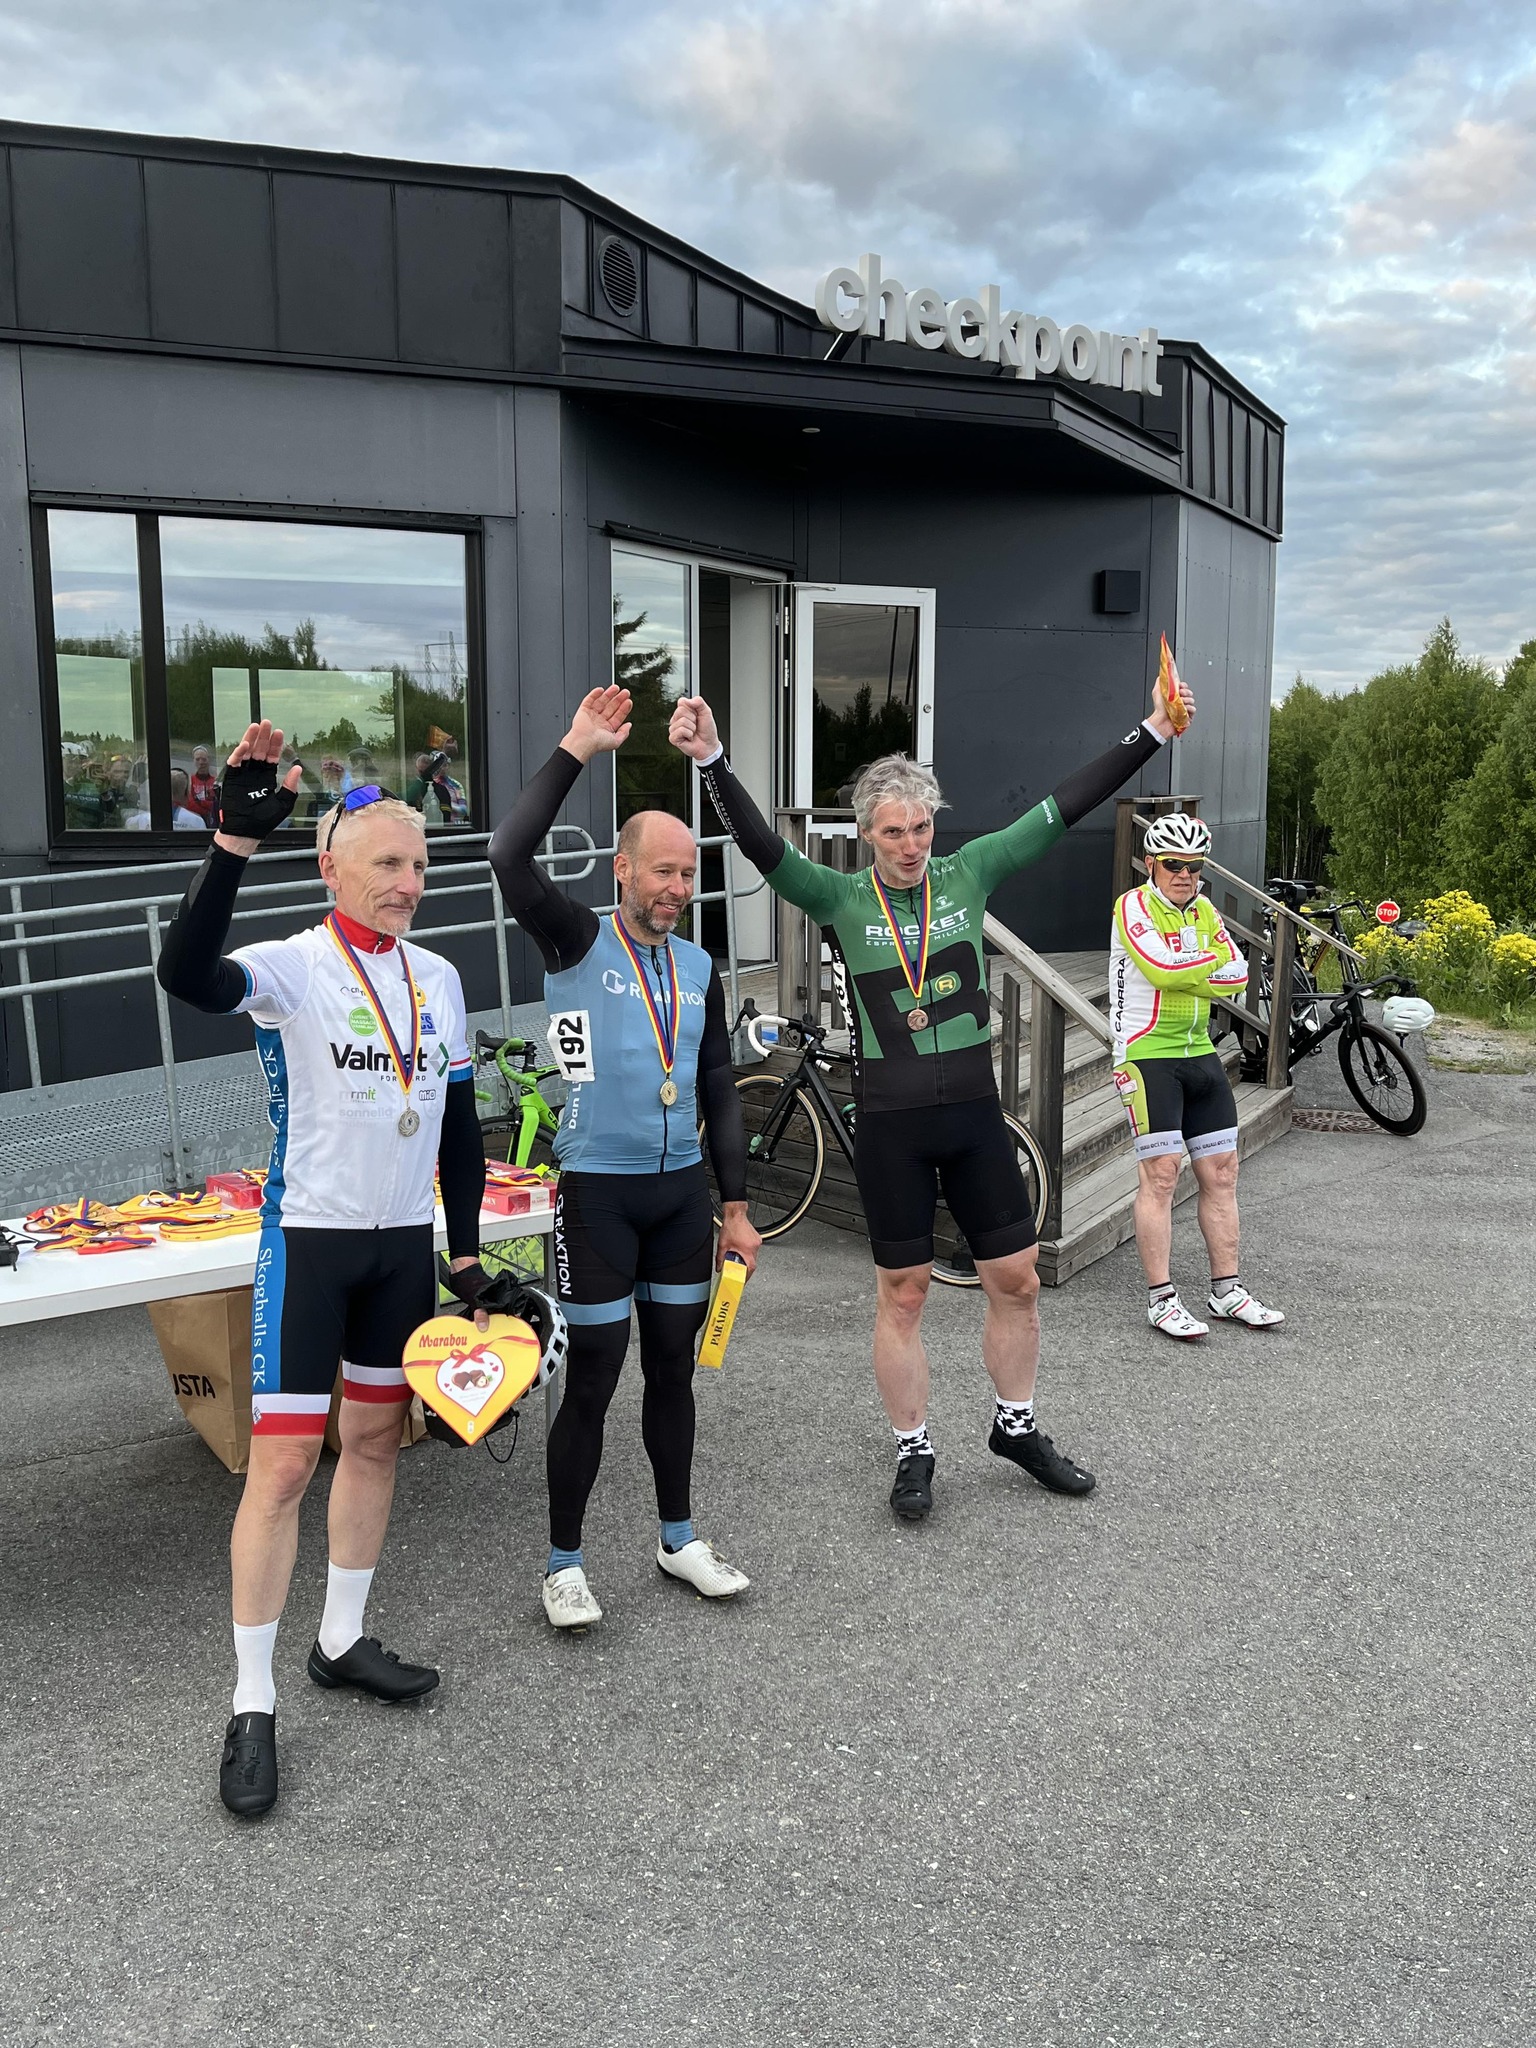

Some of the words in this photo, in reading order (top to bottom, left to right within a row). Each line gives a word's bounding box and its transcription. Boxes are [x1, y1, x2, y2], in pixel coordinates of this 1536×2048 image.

[815, 253, 1164, 397] checkpoint
[1378, 907, 1398, 917] STOP
[934, 922, 971, 941] MILANO
[1115, 957, 1126, 1033] CARRERA
[264, 1047, 278, 1078] CK
[557, 1016, 586, 1075] 192
[351, 1086, 376, 1101] rmit
[568, 1097, 580, 1130] Dan
[555, 1217, 572, 1295] RAKTION
[252, 1248, 272, 1349] Skoghalls
[418, 1333, 468, 1349] Marabou
[710, 1301, 731, 1347] PARADIS
[252, 1353, 266, 1387] CK
